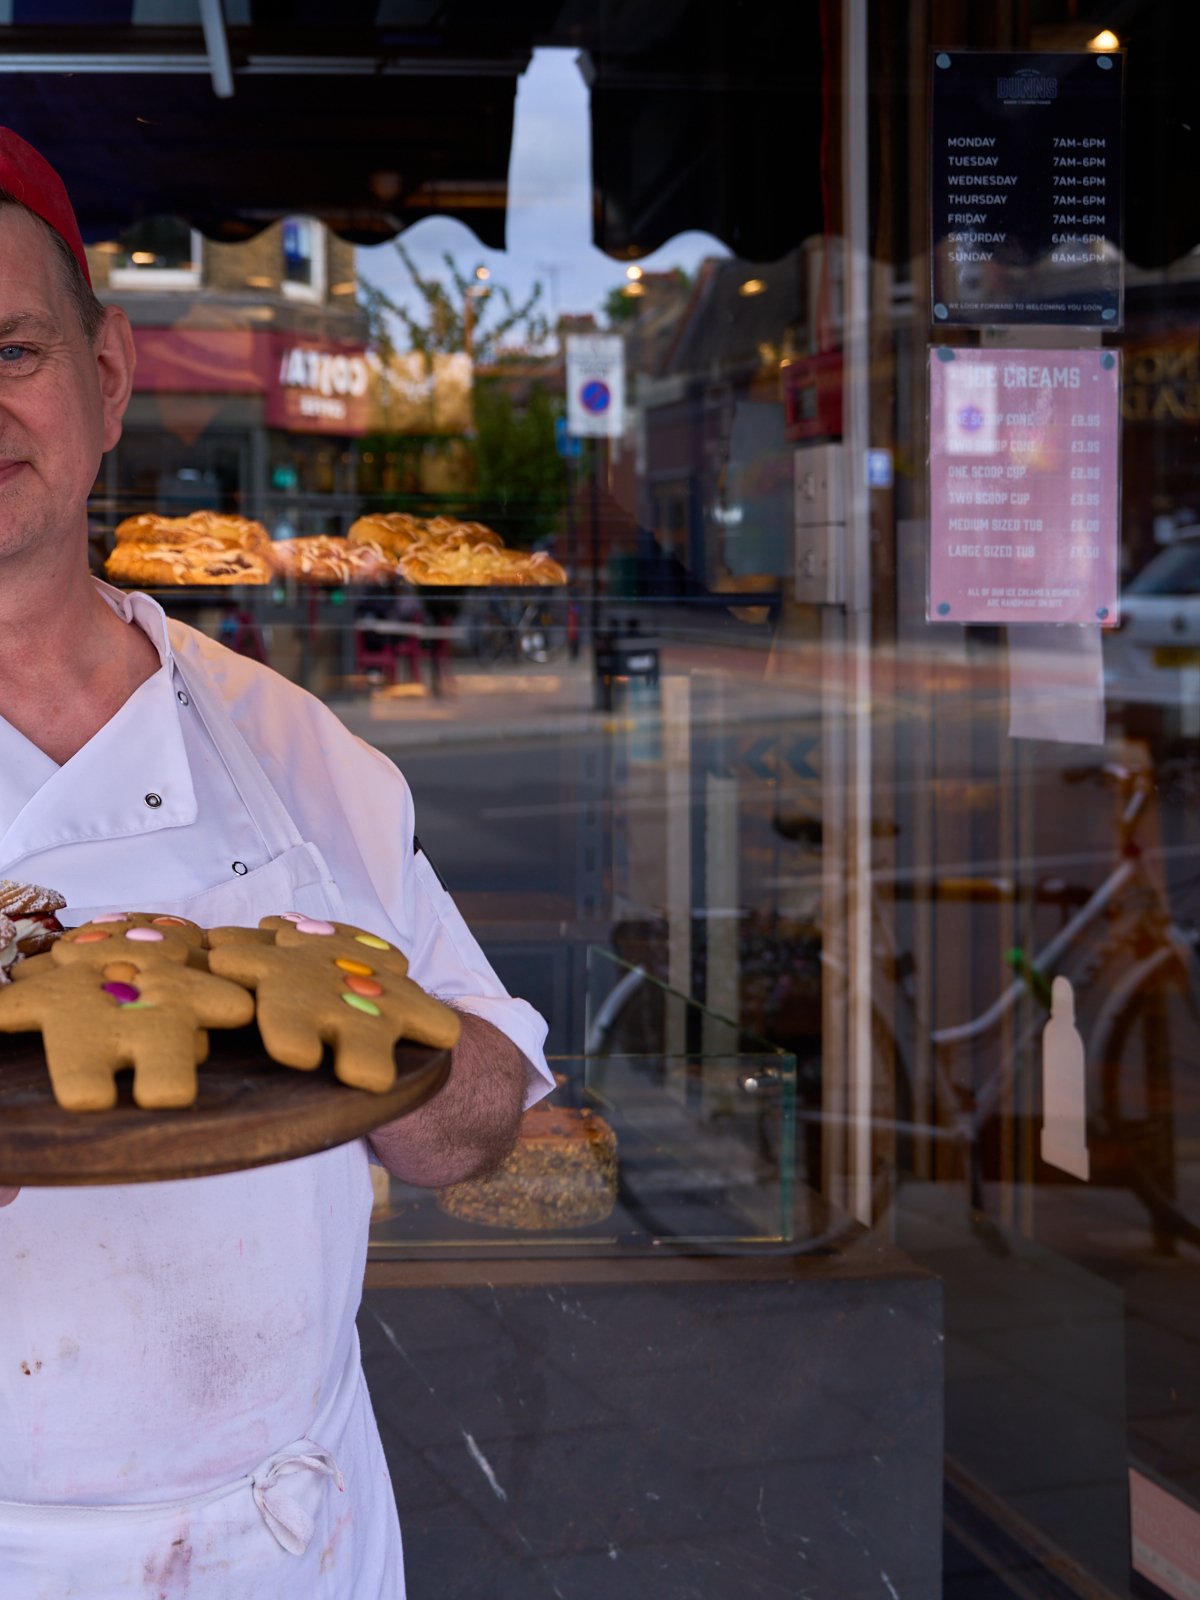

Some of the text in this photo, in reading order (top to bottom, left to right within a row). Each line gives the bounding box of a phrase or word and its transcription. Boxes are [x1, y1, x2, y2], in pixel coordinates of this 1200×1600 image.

[947, 137, 996, 148] MONDAY
[947, 156, 999, 167] TUESDAY
[947, 175, 1018, 186] WEDNESDAY
[947, 194, 1008, 205] THURSDAY
[947, 213, 987, 224] FRIDAY
[947, 232, 1006, 243] SATURDAY
[947, 252, 993, 263] SUNDAY
[1003, 366, 1081, 389] CREAMS
[949, 466, 968, 479] ONE
[971, 466, 1003, 479] SCOOP
[975, 492, 1008, 505] SCOOP
[1010, 492, 1030, 505] CUP
[948, 519, 988, 532] MEDIUM
[991, 519, 1020, 532] SIZED
[1024, 519, 1043, 532] TUB
[948, 545, 981, 558] LARGE
[984, 545, 1012, 558] SIZED
[1016, 545, 1035, 558] TUB
